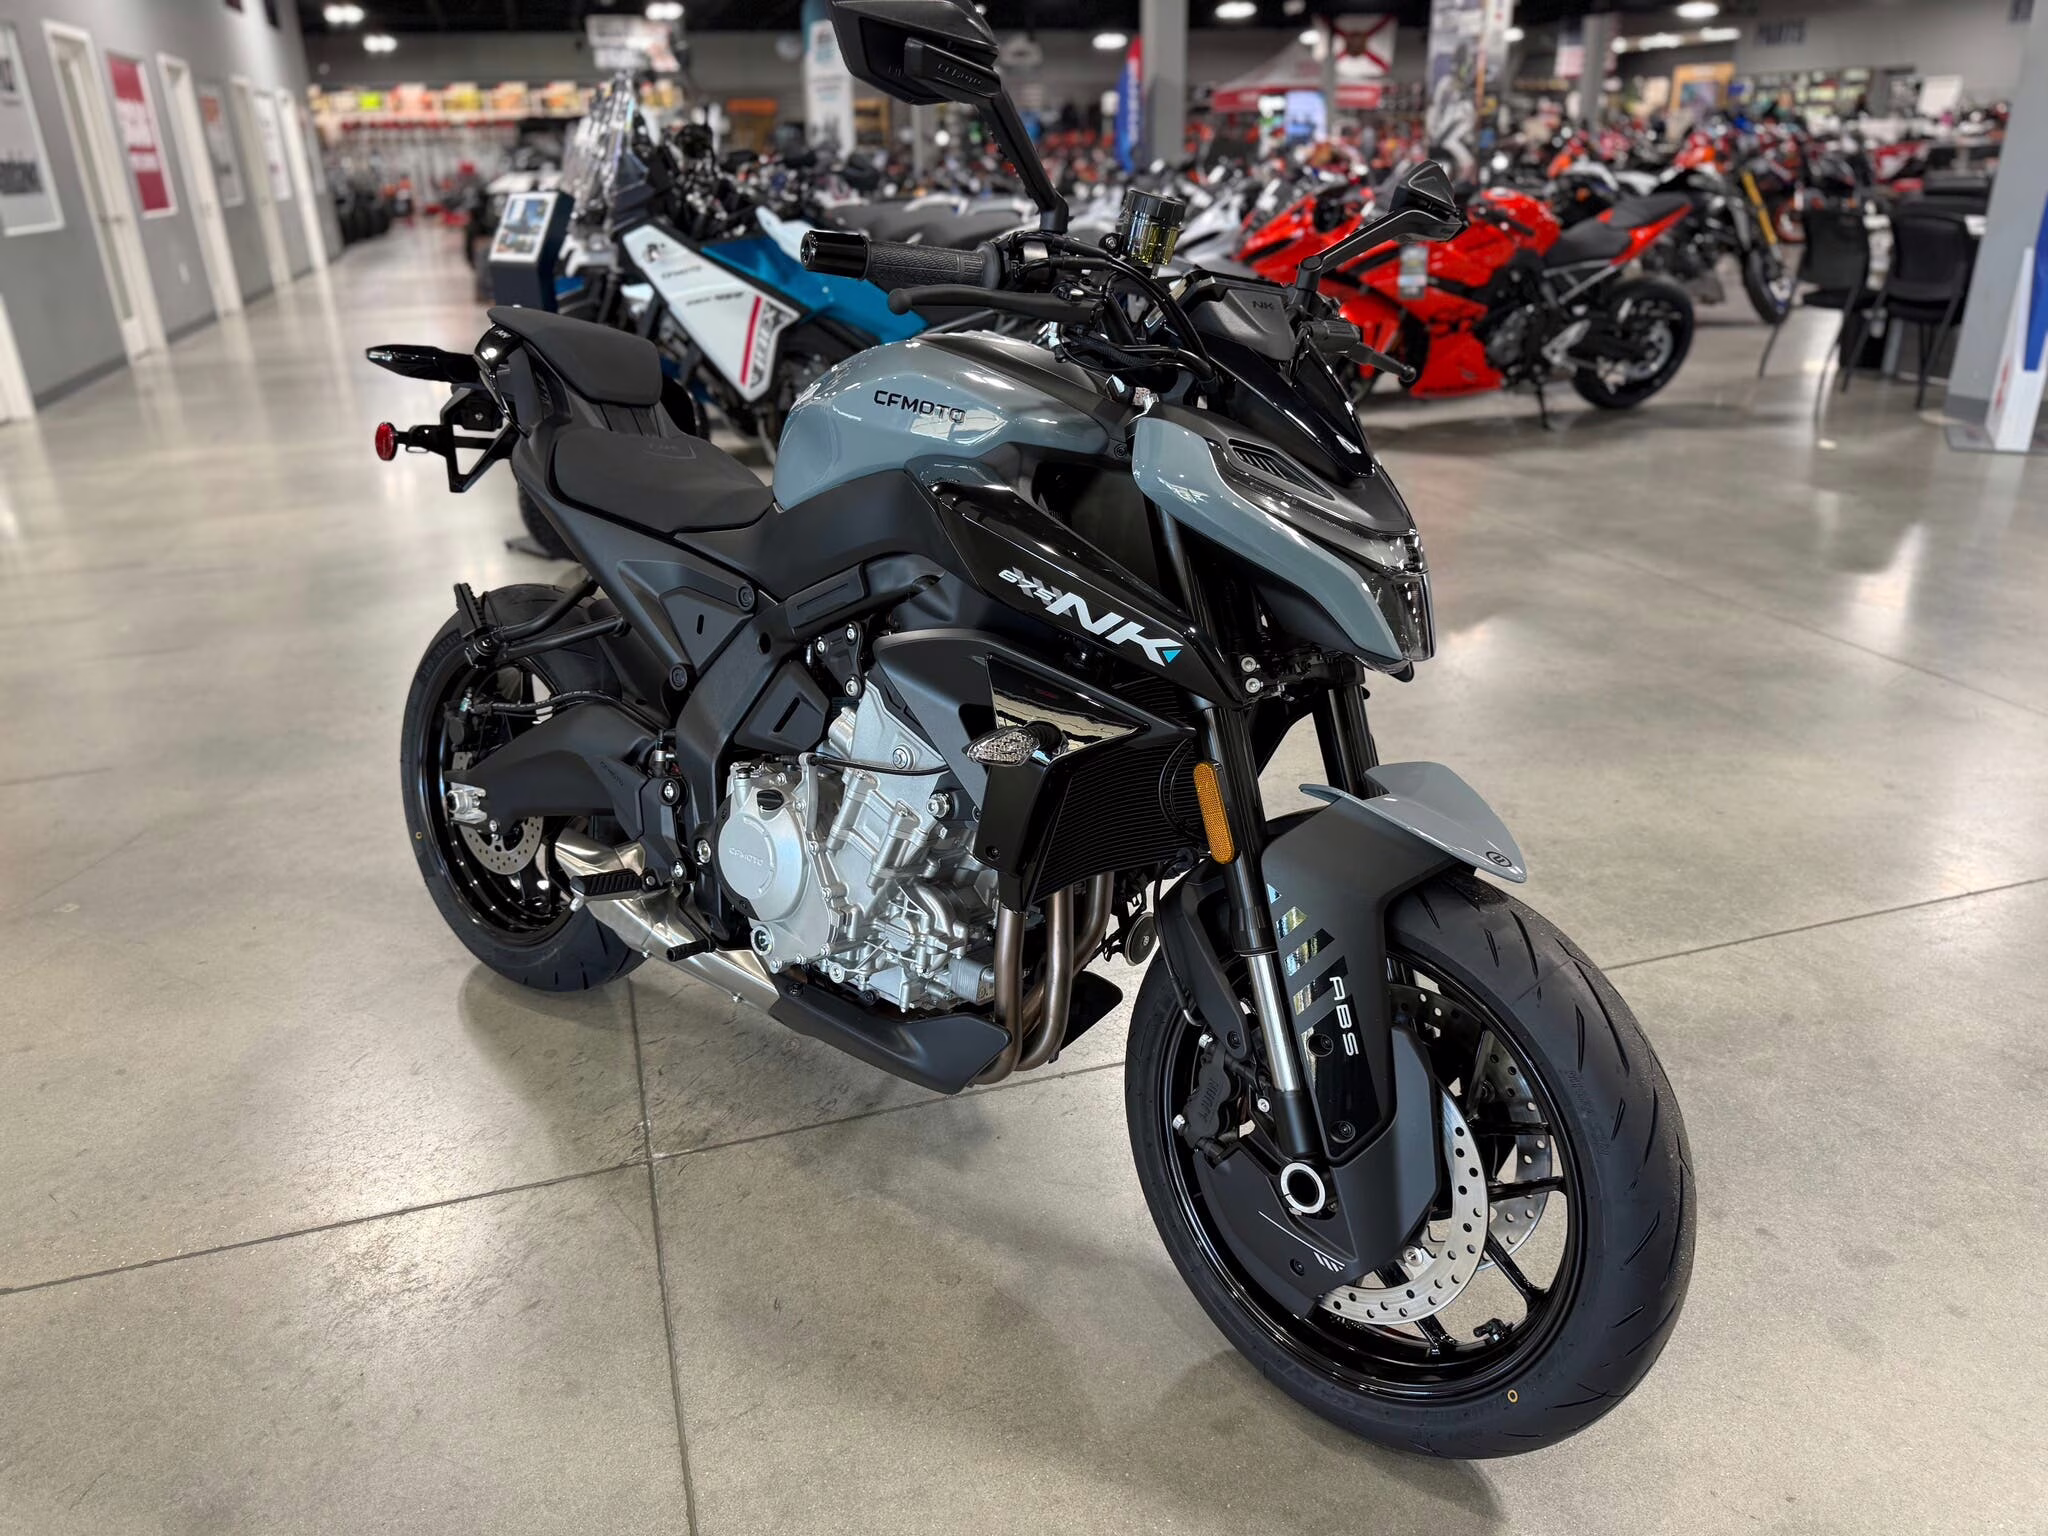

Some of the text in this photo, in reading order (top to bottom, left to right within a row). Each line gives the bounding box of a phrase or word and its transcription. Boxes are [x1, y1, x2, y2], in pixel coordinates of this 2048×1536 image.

[1252, 301, 1273, 310] NK
[873, 389, 967, 424] CFMOTO
[998, 568, 1184, 667] 675 NK
[728, 847, 764, 867] CFMOTO
[1329, 976, 1360, 1057] ABS
